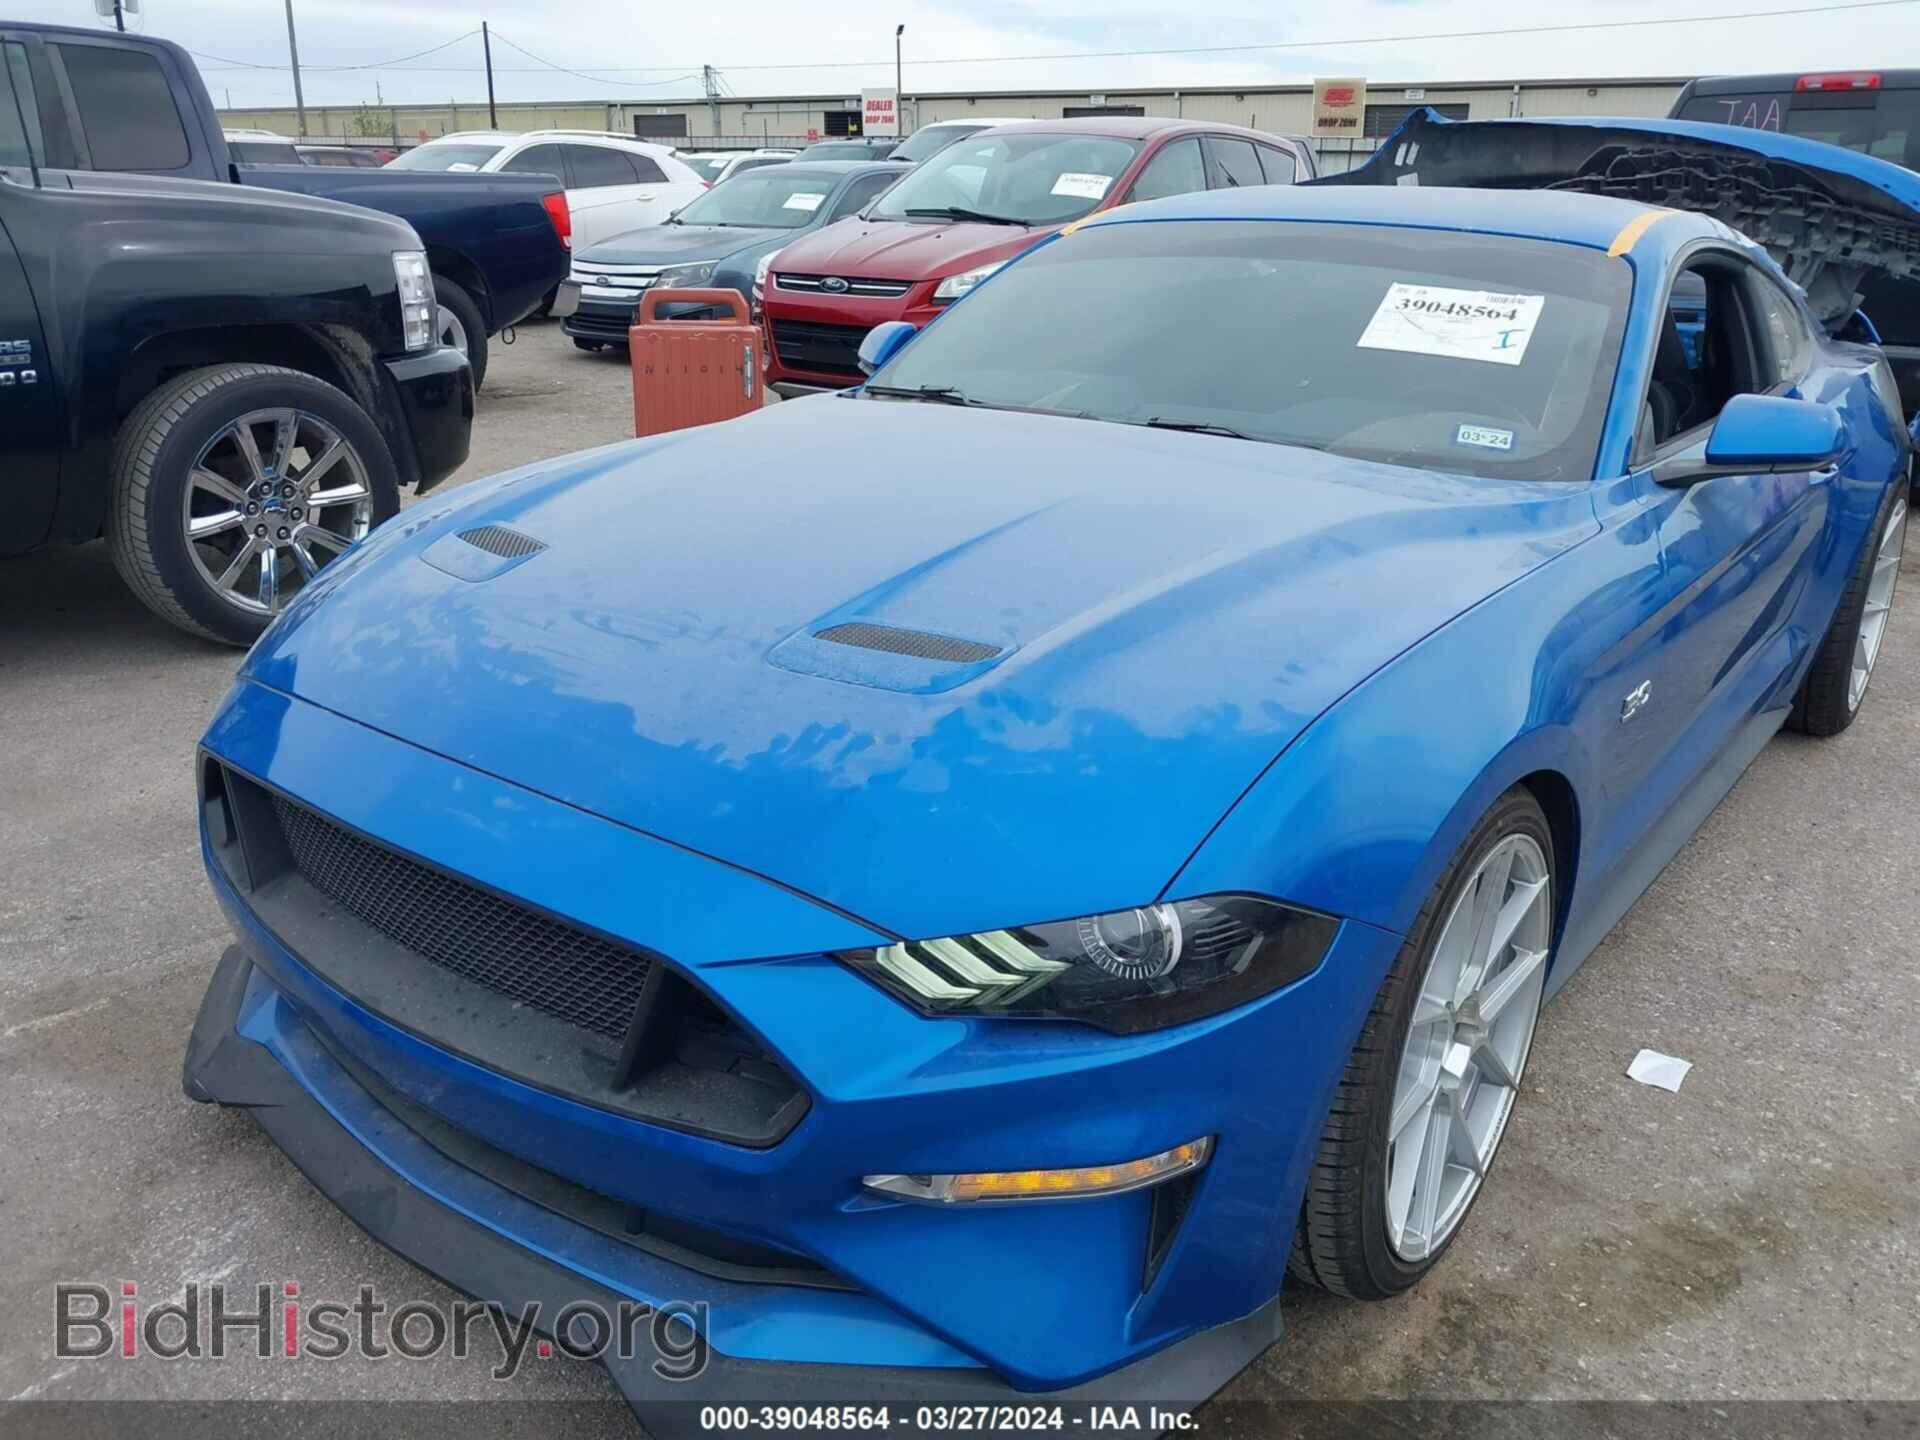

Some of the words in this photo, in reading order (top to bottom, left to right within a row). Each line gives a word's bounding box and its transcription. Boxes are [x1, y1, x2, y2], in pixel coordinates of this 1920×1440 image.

[866, 100, 893, 111] DEALER
[864, 115, 880, 124] DROP
[881, 115, 895, 124] ZONE
[1318, 118, 1338, 127] DROP
[1338, 118, 1358, 127] ZONE
